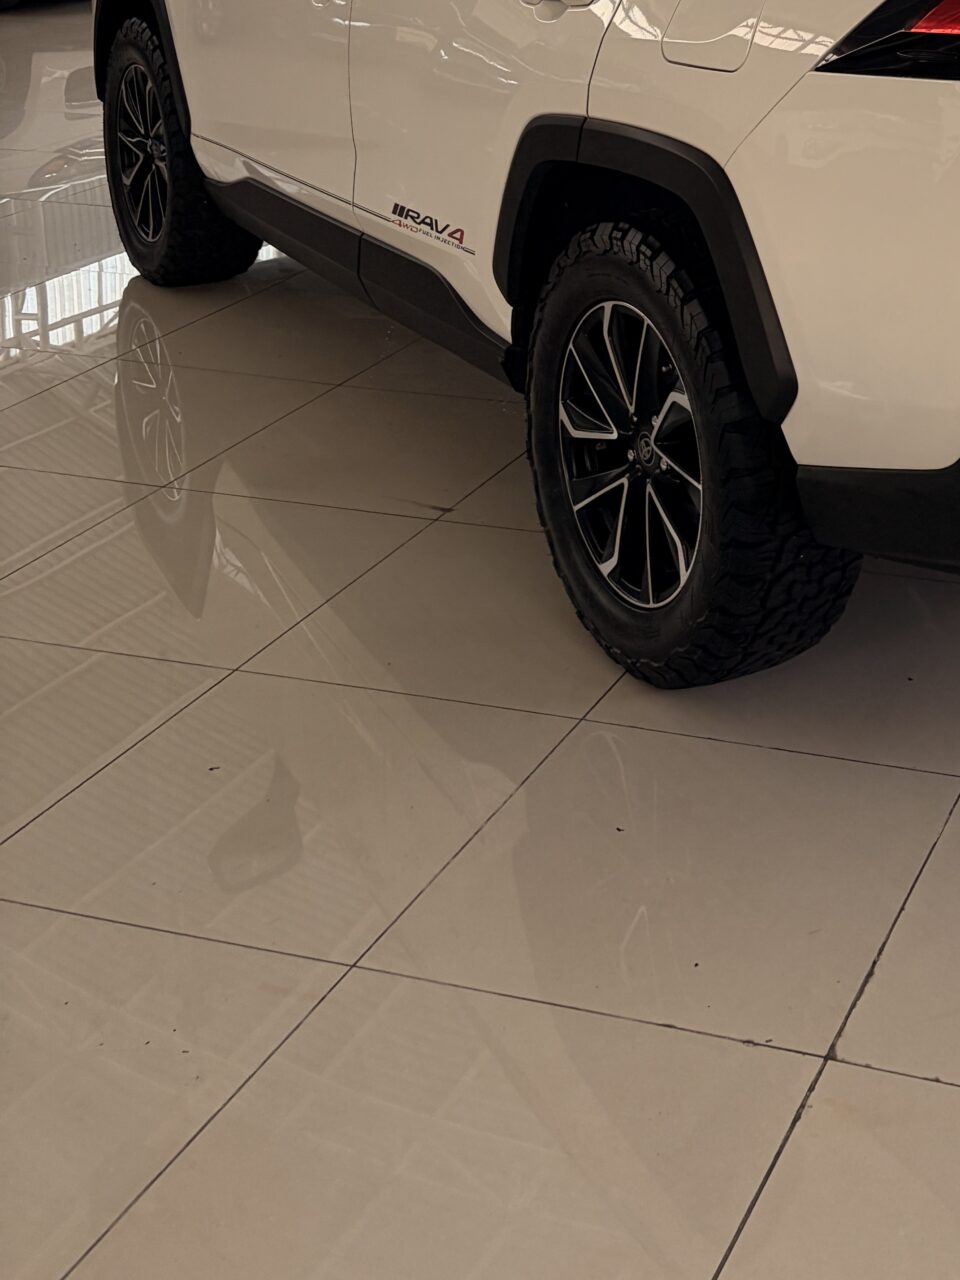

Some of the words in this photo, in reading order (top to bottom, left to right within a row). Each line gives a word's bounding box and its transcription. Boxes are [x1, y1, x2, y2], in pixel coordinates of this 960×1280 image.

[392, 219, 418, 234] 4WD
[418, 228, 433, 239] FUEL
[404, 207, 465, 245] RAV4
